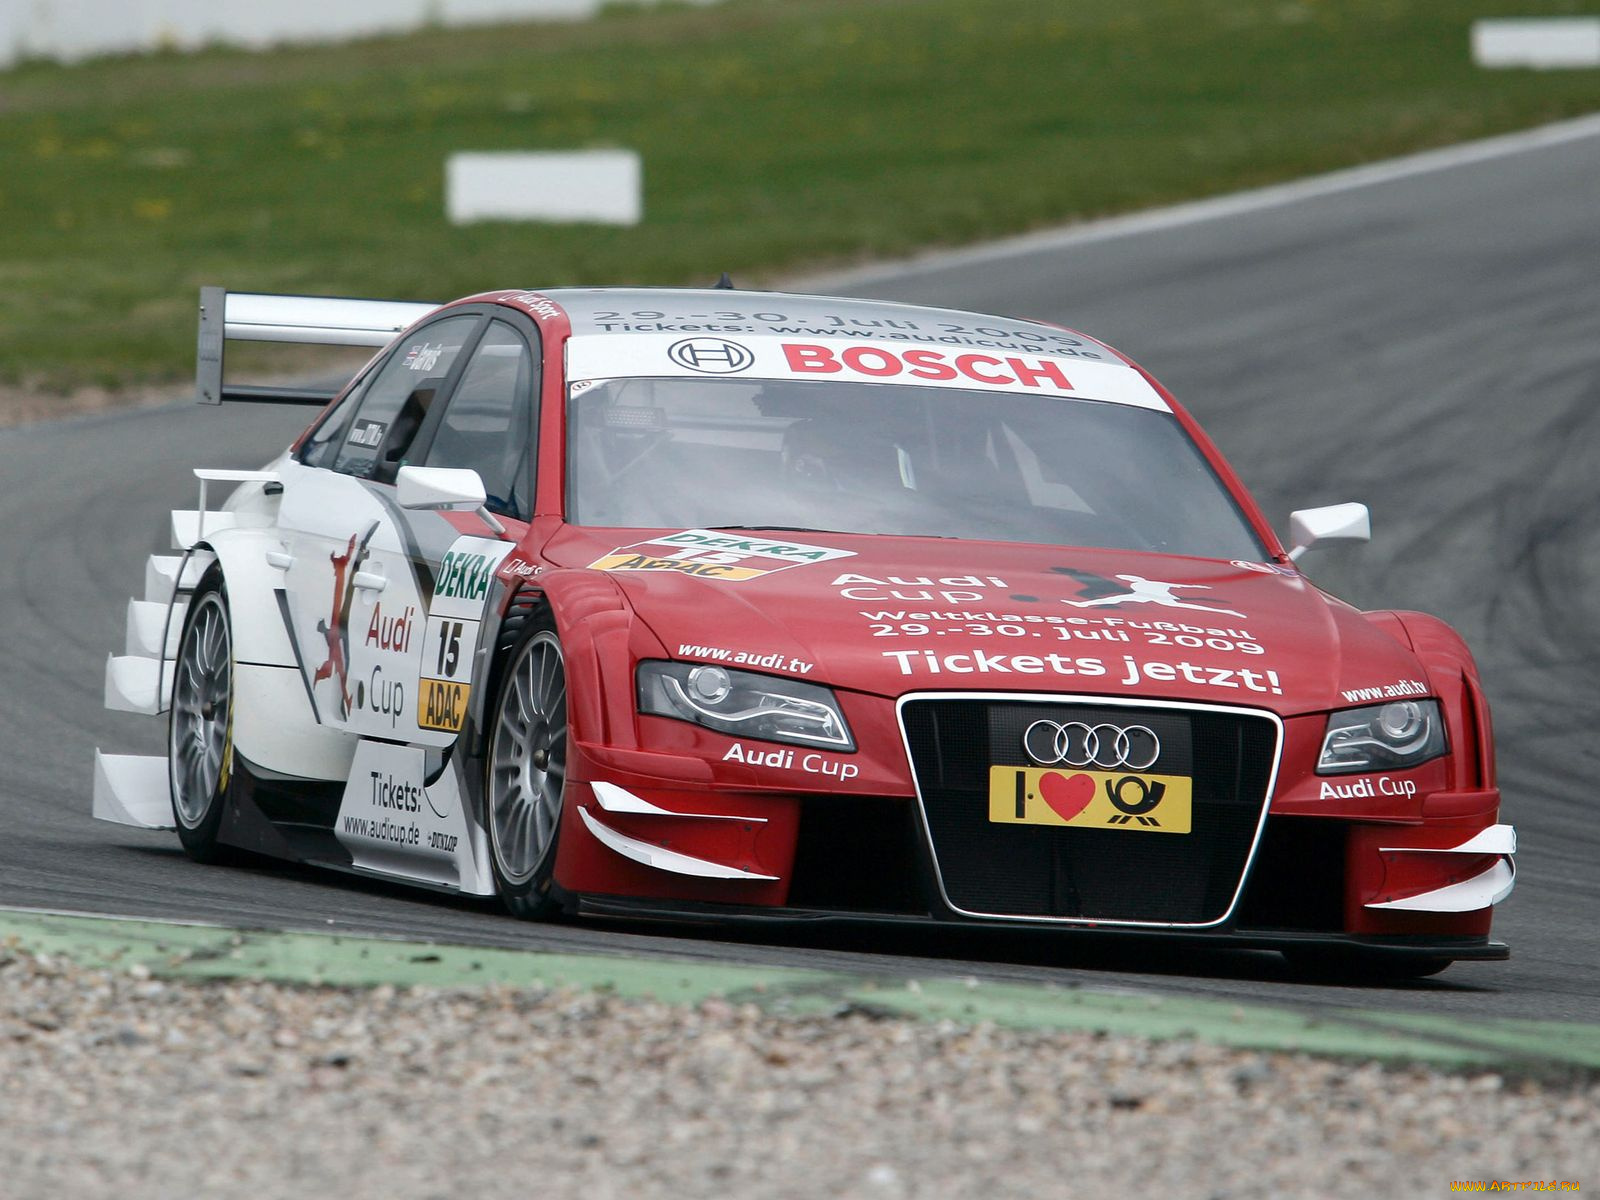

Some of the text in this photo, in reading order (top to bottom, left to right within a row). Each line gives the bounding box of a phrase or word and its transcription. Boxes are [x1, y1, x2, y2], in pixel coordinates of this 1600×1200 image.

[593, 310, 1084, 348] 29.-30. Juli 2009
[595, 322, 1103, 360] Tickets: www.audicup.de
[781, 343, 1075, 391] BOSCH
[662, 533, 829, 561] DEKRA
[434, 551, 497, 601] DEKRA
[612, 556, 734, 576] ADAC
[831, 573, 1009, 588] Audi
[840, 587, 984, 604] Cup
[365, 601, 415, 653] Audi
[858, 611, 1257, 640] Weltklasse-Fußball
[868, 623, 1265, 656] 29.-30. Juli 2009
[437, 620, 464, 678] 15
[677, 643, 814, 674] www.audi.tv
[881, 649, 1284, 696] Tickets jetzt!
[370, 664, 404, 729] Cup
[426, 682, 461, 729] ADAC
[1341, 679, 1428, 703] www.audi.tv
[722, 742, 860, 782] Audi Cup
[370, 770, 422, 813] Tickets:
[1319, 776, 1417, 800] Audi Cup
[343, 815, 420, 849] www.audicup.de
[430, 831, 459, 853] DUNLOP
